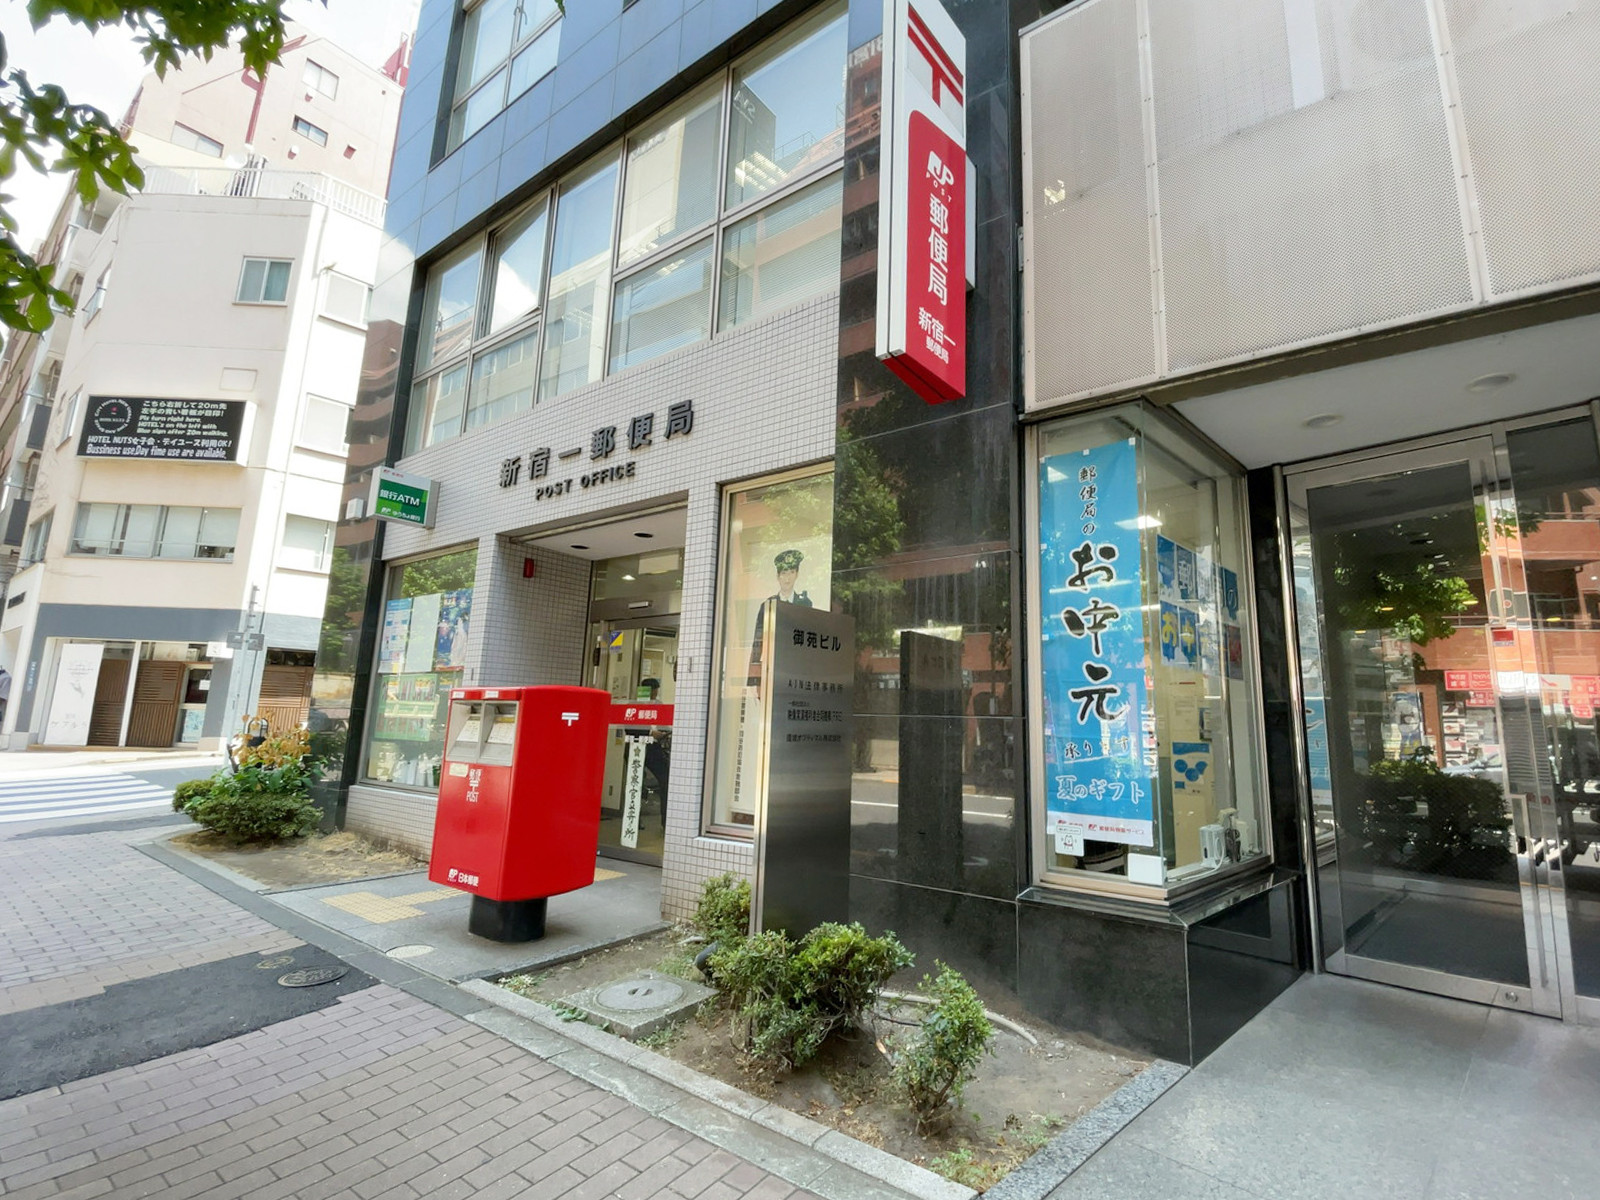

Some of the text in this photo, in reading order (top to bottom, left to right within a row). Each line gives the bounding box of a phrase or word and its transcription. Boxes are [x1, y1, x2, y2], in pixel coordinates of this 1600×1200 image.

[928, 192, 949, 306] 郵便局
[918, 306, 956, 345] 新宿一
[926, 335, 949, 364] 郵便局
[86, 443, 122, 455] Bussiness
[150, 445, 166, 456] time
[167, 448, 181, 457] use
[181, 449, 195, 457] are
[87, 435, 111, 443] HOTEL
[500, 400, 695, 488] 新宿一郵便局
[536, 461, 636, 501] POST OFFICE
[380, 489, 420, 506] 銀行ATM
[1079, 465, 1098, 535] 郵便局の
[793, 629, 841, 651] 御苑ビル
[1061, 542, 1130, 725] お中元
[638, 710, 658, 720] 郵便局
[469, 769, 482, 781] 郵便
[466, 791, 479, 802] POST
[1055, 774, 1145, 805] 夏のギフト
[458, 872, 479, 887] 日本郵便
